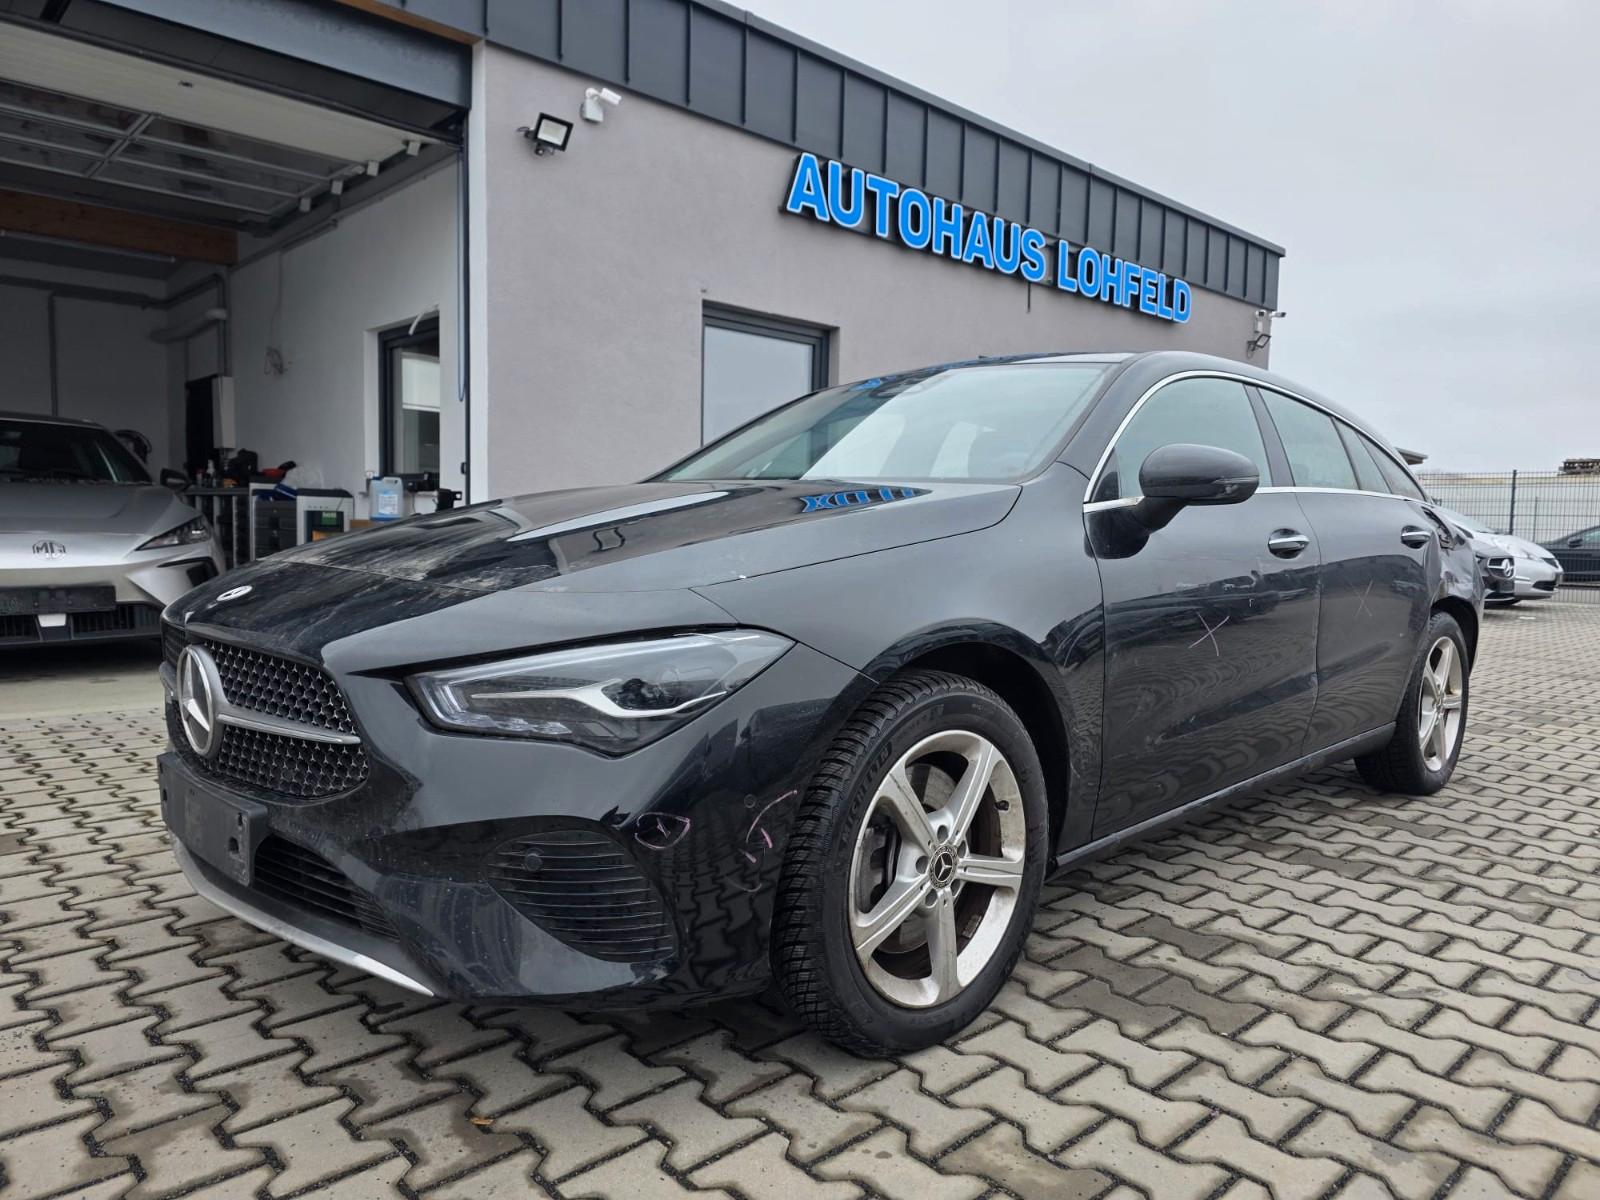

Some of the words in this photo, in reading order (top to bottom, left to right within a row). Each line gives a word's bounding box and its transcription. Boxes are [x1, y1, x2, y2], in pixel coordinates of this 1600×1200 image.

[786, 152, 1047, 282] AUTOHAUS
[1057, 239, 1191, 324] LOHFELD
[33, 540, 66, 560] MG
